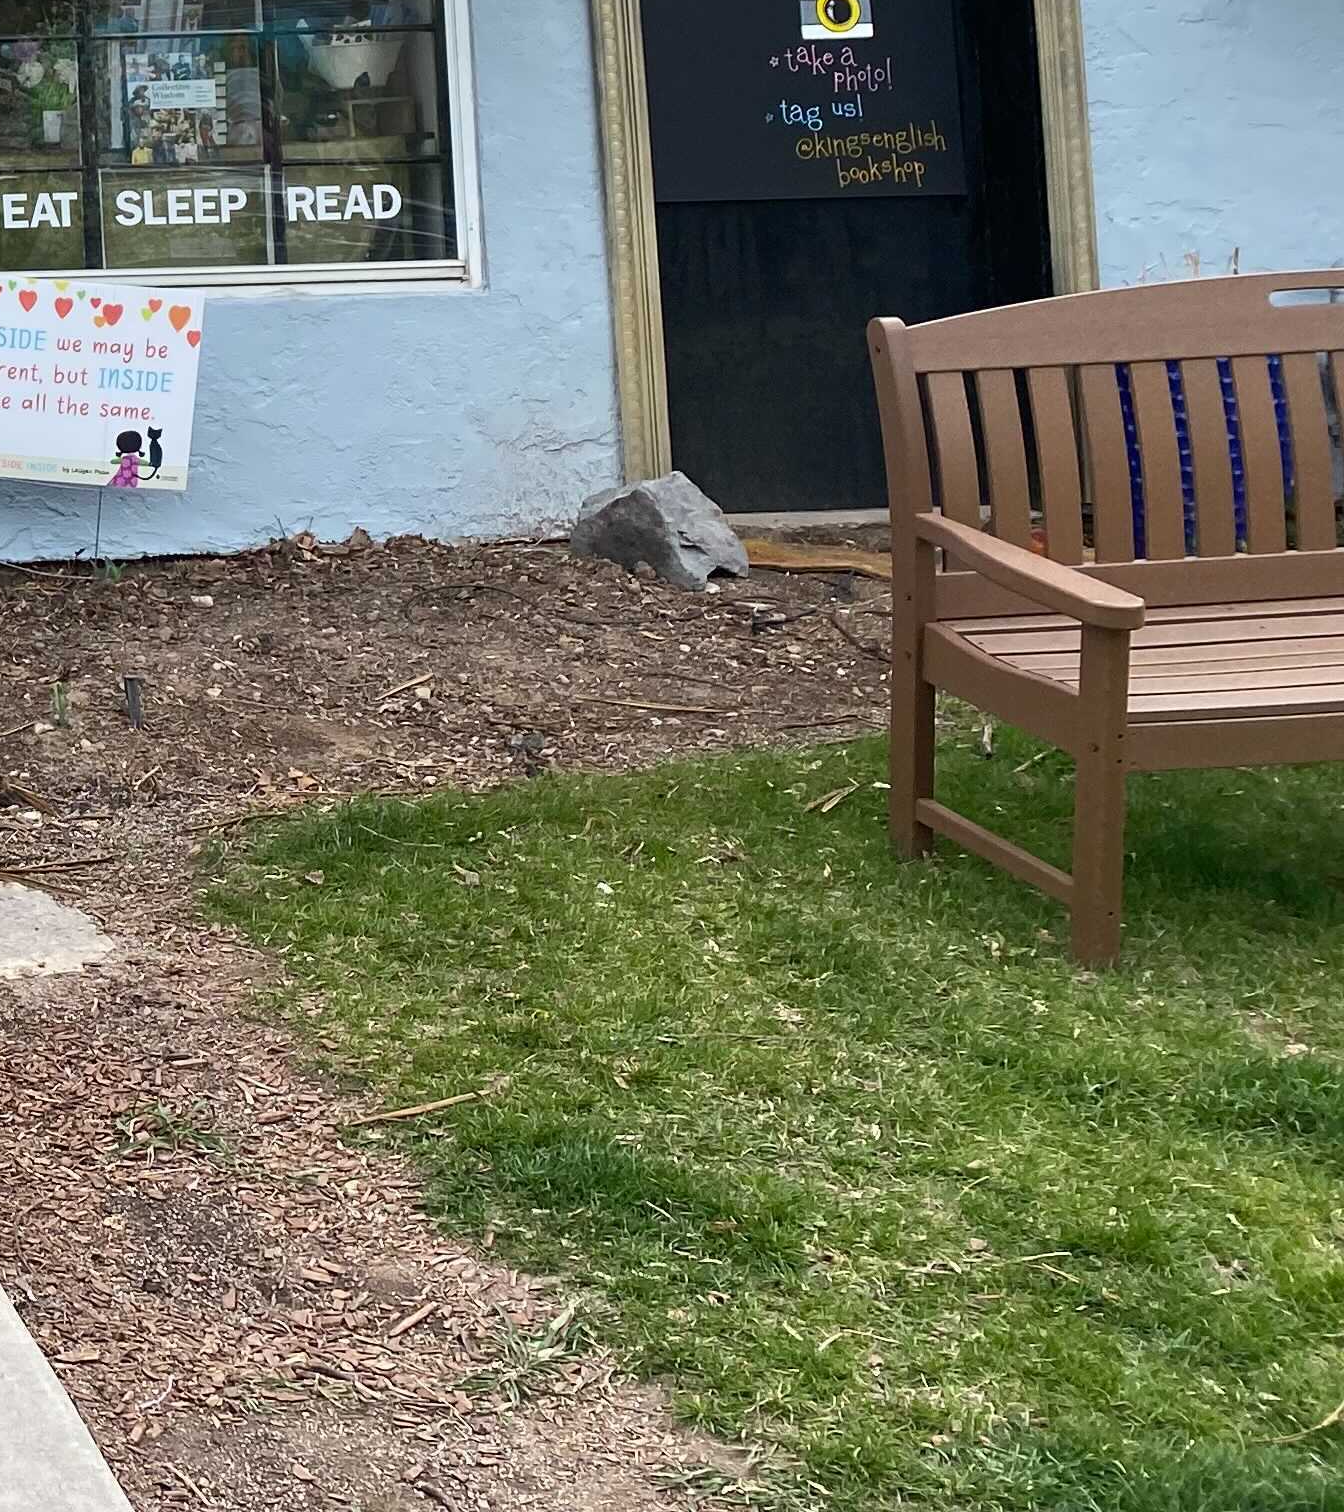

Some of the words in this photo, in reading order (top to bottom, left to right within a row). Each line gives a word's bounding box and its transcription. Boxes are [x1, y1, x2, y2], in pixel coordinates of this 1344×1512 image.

[784, 44, 834, 75] take
[840, 46, 857, 67] a
[834, 57, 893, 93] photo!
[779, 99, 823, 131] tag
[832, 94, 863, 121] us!
[796, 120, 947, 159] @kingsenglish
[836, 153, 925, 188] bookshop
[2, 191, 78, 229] EAT
[114, 188, 248, 226] SLEEP
[286, 183, 403, 223] READ
[56, 337, 82, 353] we
[93, 339, 134, 364] may
[145, 338, 169, 359] be
[53, 364, 89, 386] but
[22, 393, 47, 413] all
[57, 394, 90, 416] the
[99, 402, 156, 421] same.
